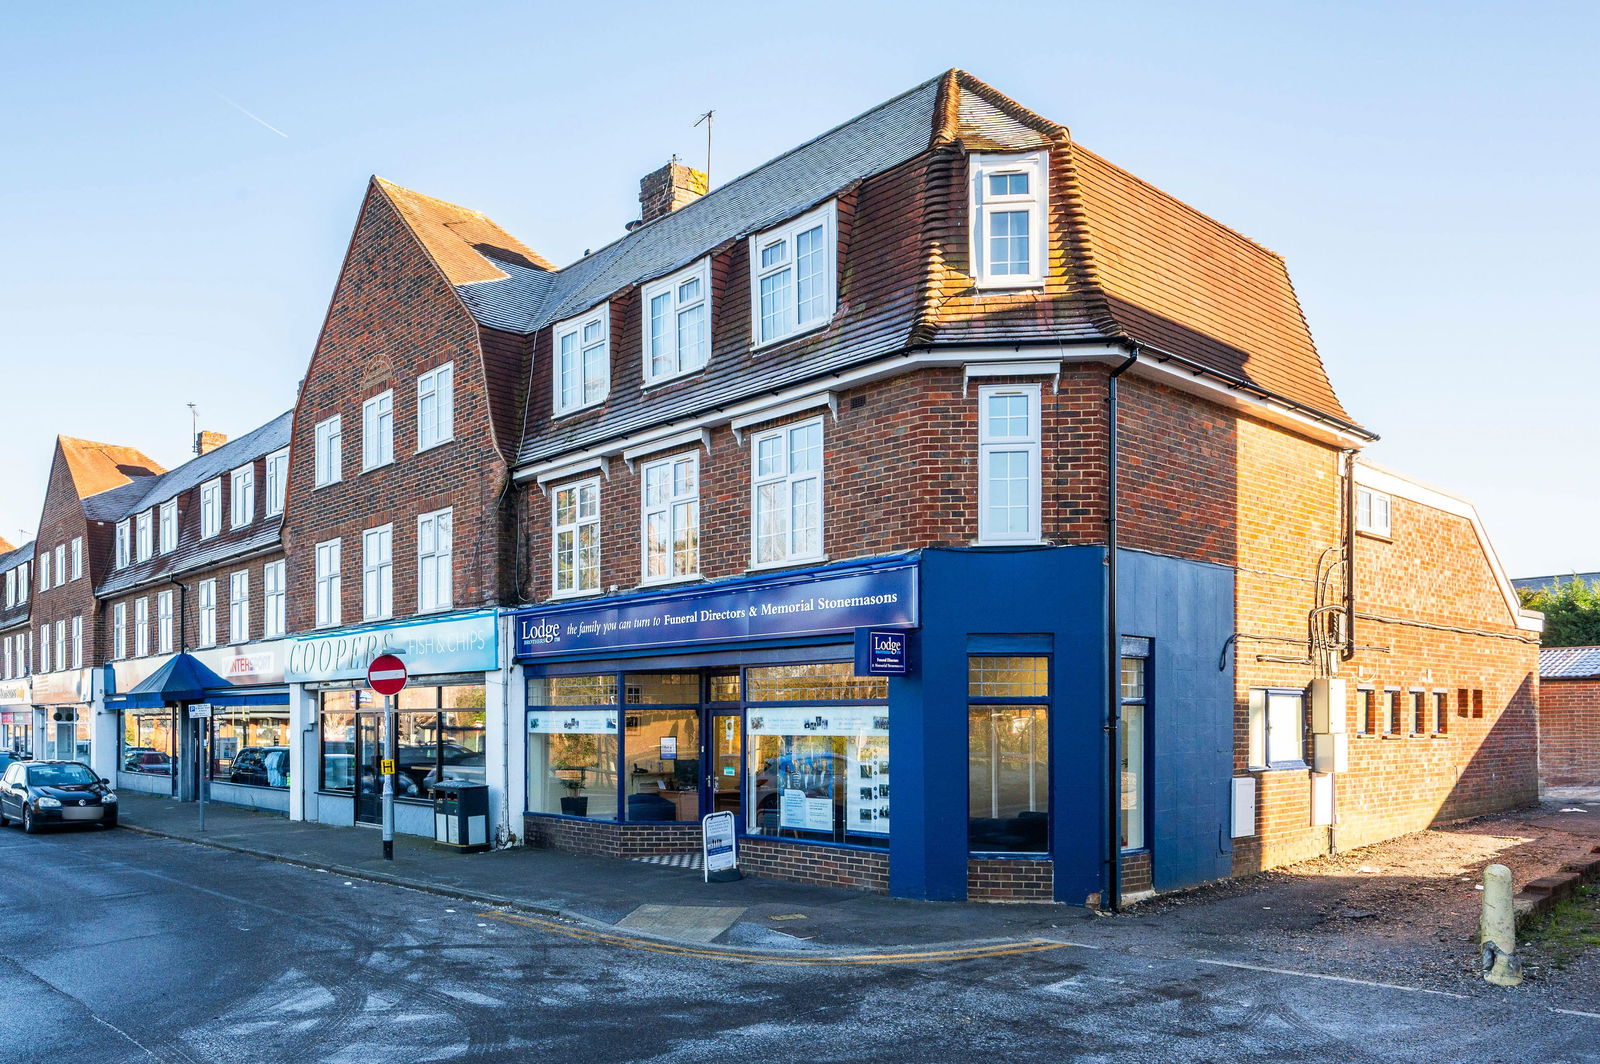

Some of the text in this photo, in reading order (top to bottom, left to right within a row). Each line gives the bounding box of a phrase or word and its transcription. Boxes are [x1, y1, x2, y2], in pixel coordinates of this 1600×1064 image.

[566, 592, 898, 637] the family you can turn to Funeral Directors & Memorial Stonemasons
[408, 638, 433, 656] FISH
[436, 638, 445, 654] &
[447, 630, 486, 653] CHIPS
[521, 618, 560, 643] Lodge
[874, 636, 901, 655] Lodge
[382, 760, 393, 773] H
